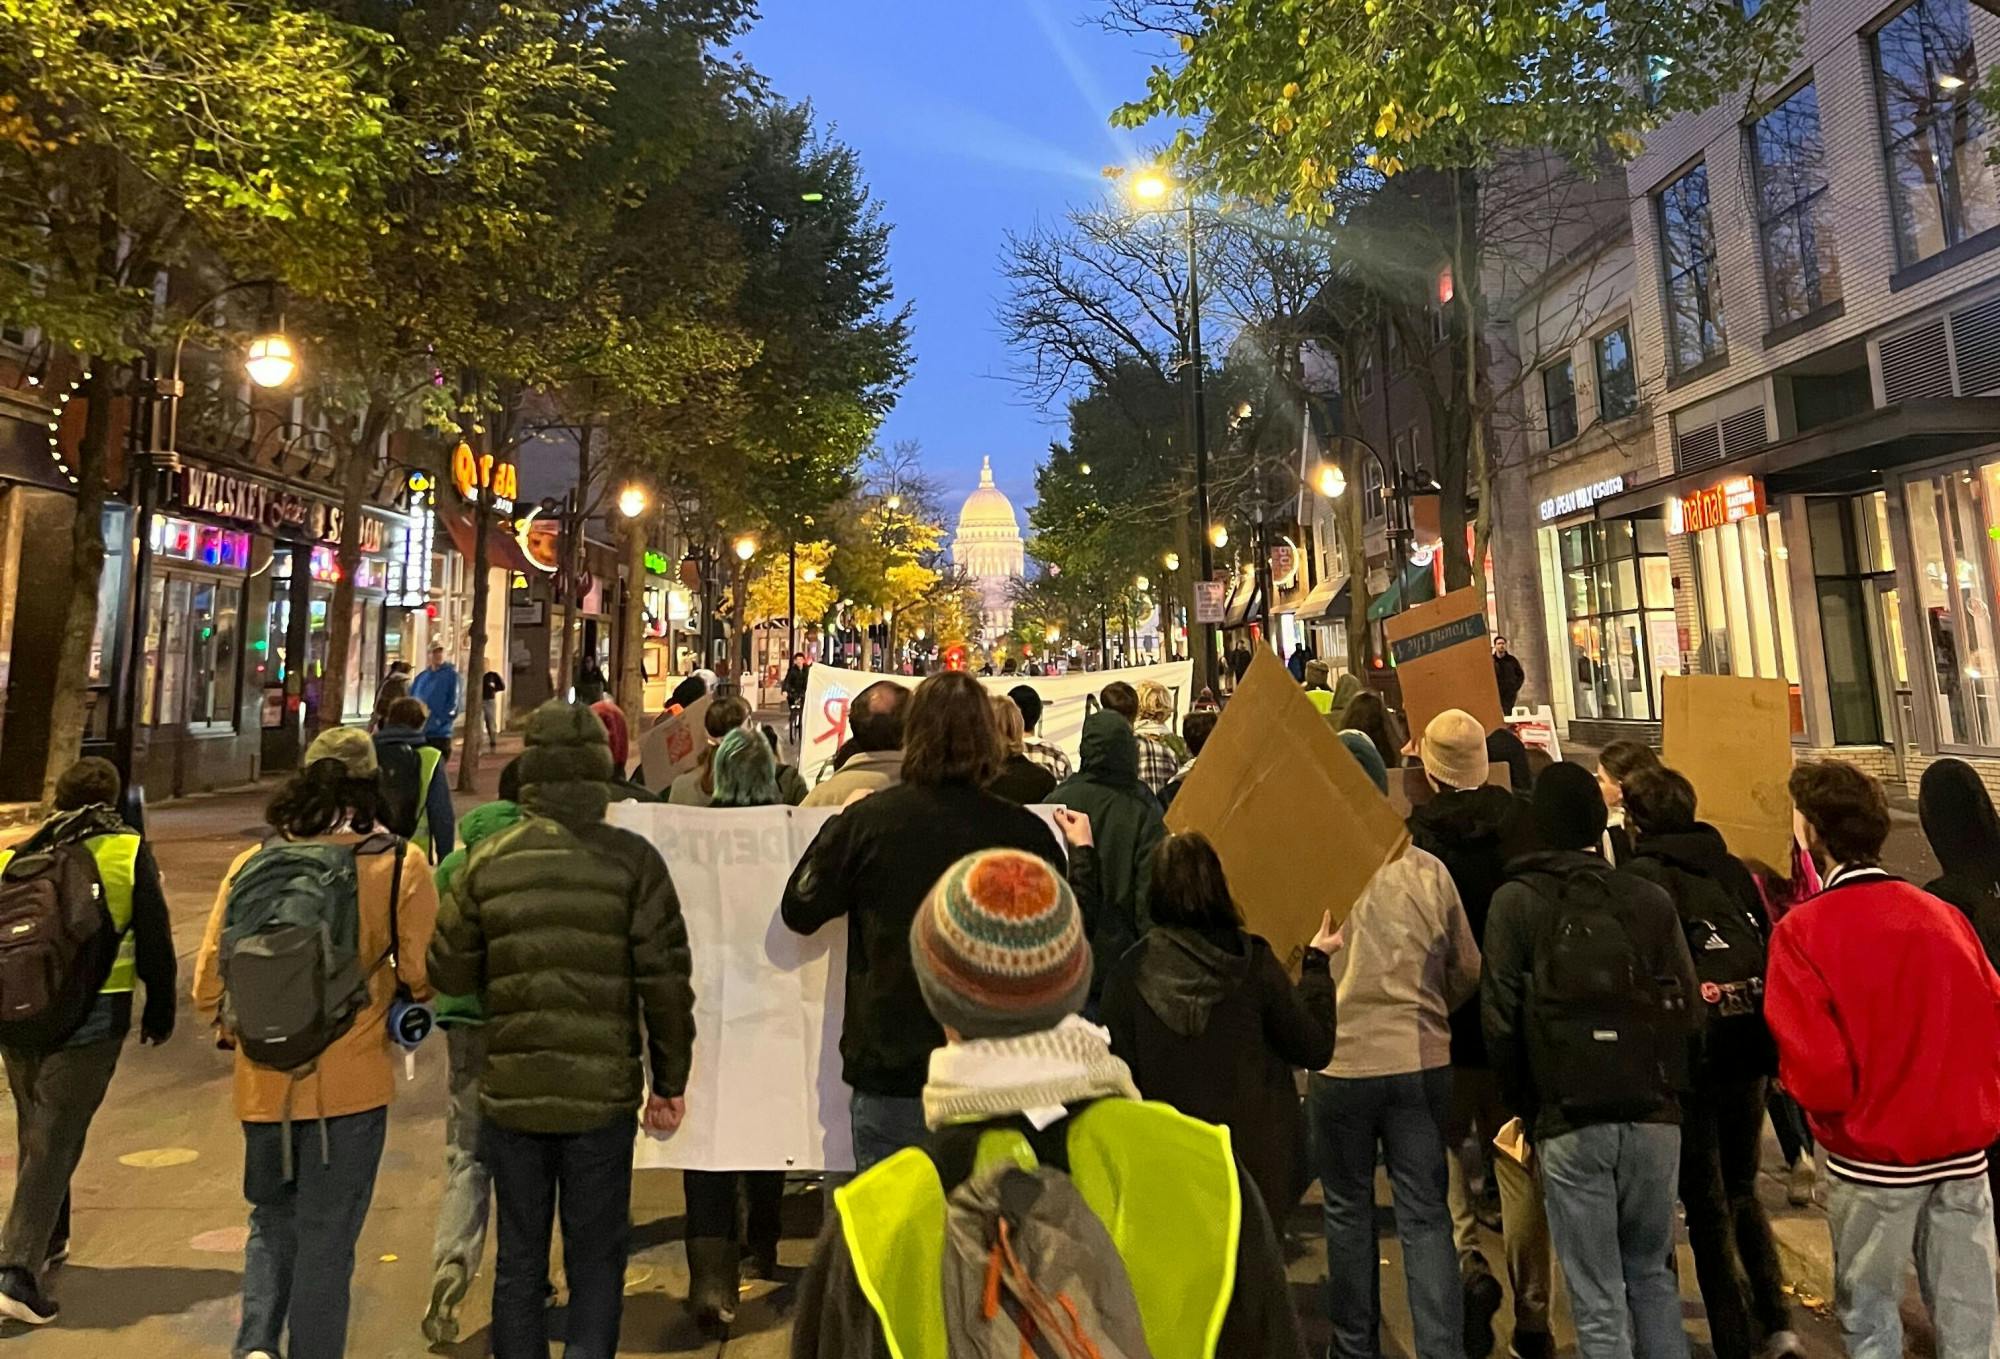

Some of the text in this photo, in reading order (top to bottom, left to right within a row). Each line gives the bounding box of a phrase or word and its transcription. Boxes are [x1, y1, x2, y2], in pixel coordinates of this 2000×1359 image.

[187, 467, 268, 523] WHISKEY
[1540, 491, 1577, 520] EURPEAN
[1575, 486, 1595, 509] WAX
[1683, 489, 1703, 532] naf
[1703, 484, 1724, 528] naf
